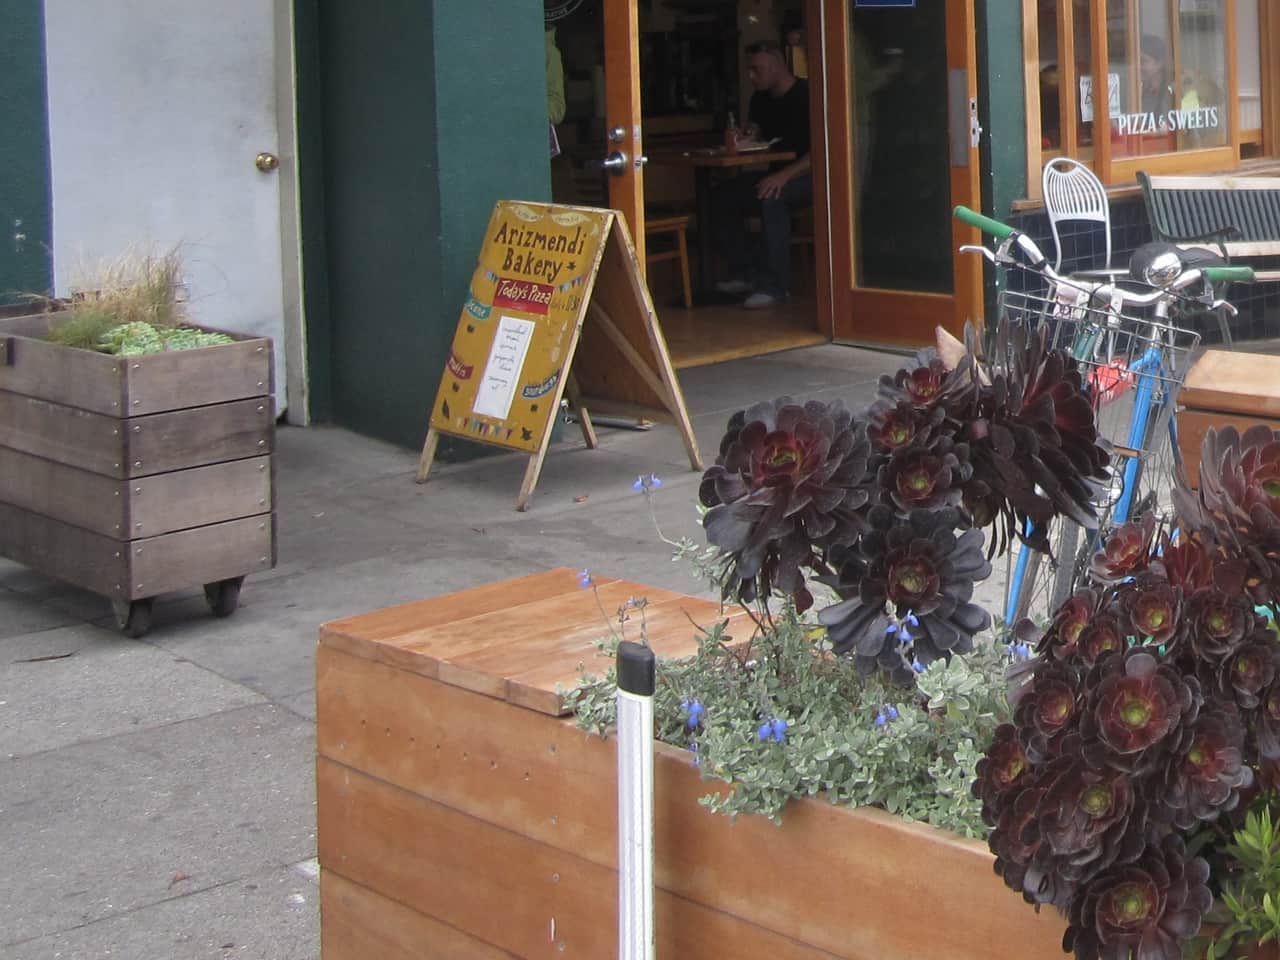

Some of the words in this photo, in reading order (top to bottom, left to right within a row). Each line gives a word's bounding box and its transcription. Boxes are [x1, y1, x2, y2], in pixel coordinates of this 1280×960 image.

[1118, 112, 1156, 136] PIZZA
[1158, 115, 1166, 129] &
[1168, 107, 1218, 131] SWEETS
[494, 222, 587, 255] Arizmendi
[502, 247, 563, 284] Bakery
[499, 280, 527, 300] Today's
[528, 283, 552, 304] Pizza
